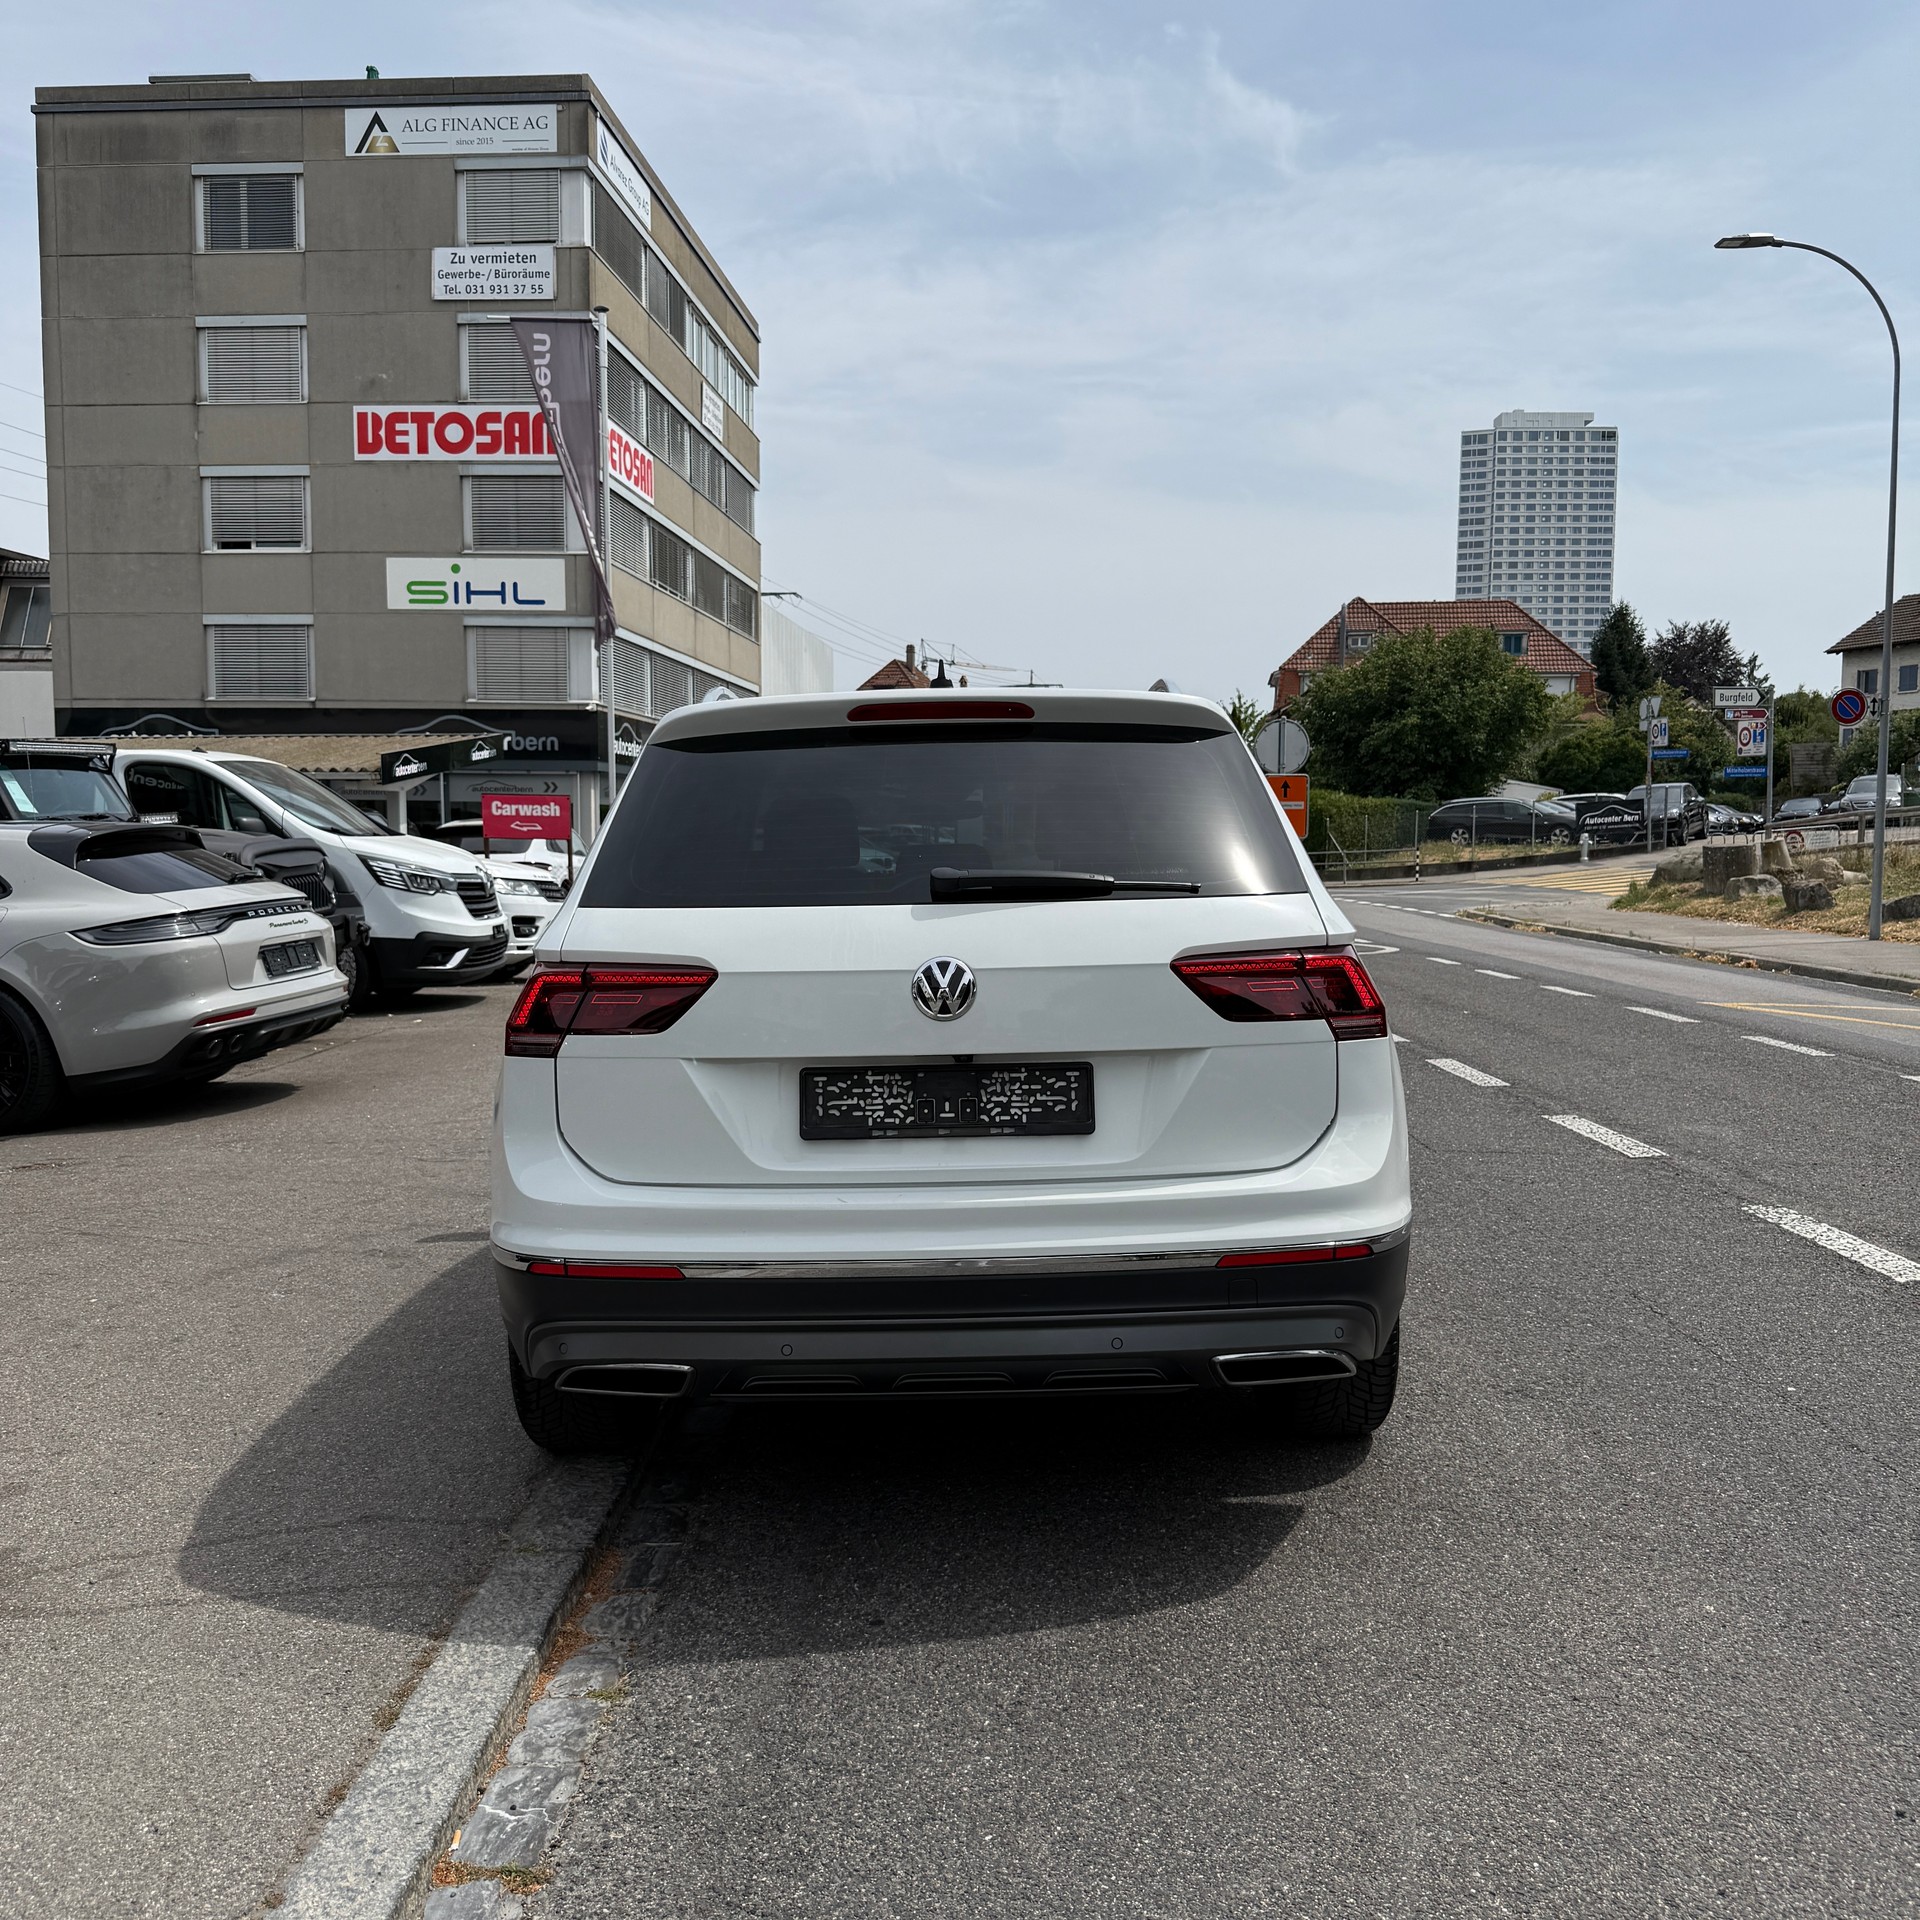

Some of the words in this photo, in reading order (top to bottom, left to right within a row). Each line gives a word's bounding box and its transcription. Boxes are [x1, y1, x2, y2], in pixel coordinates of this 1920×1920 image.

[401, 118, 437, 133] ALG
[441, 116, 519, 131] FINANCE
[523, 115, 549, 130] AG
[455, 138, 475, 146] since
[476, 137, 494, 145] 2015
[450, 252, 466, 264] Zu
[470, 251, 537, 264] vermieten
[443, 284, 462, 294] Tel.
[465, 284, 485, 294] 031
[489, 284, 509, 294] 931
[513, 284, 526, 294] 37
[530, 284, 544, 294] 55
[356, 411, 557, 455] BETOSAN
[608, 427, 654, 499] ETOSAN
[1719, 692, 1753, 704] Burgfeld
[491, 800, 561, 818] Carwash
[1584, 816, 1622, 825] Autocenter
[1623, 814, 1639, 822] Bern
[247, 904, 304, 918] PORSCHE
